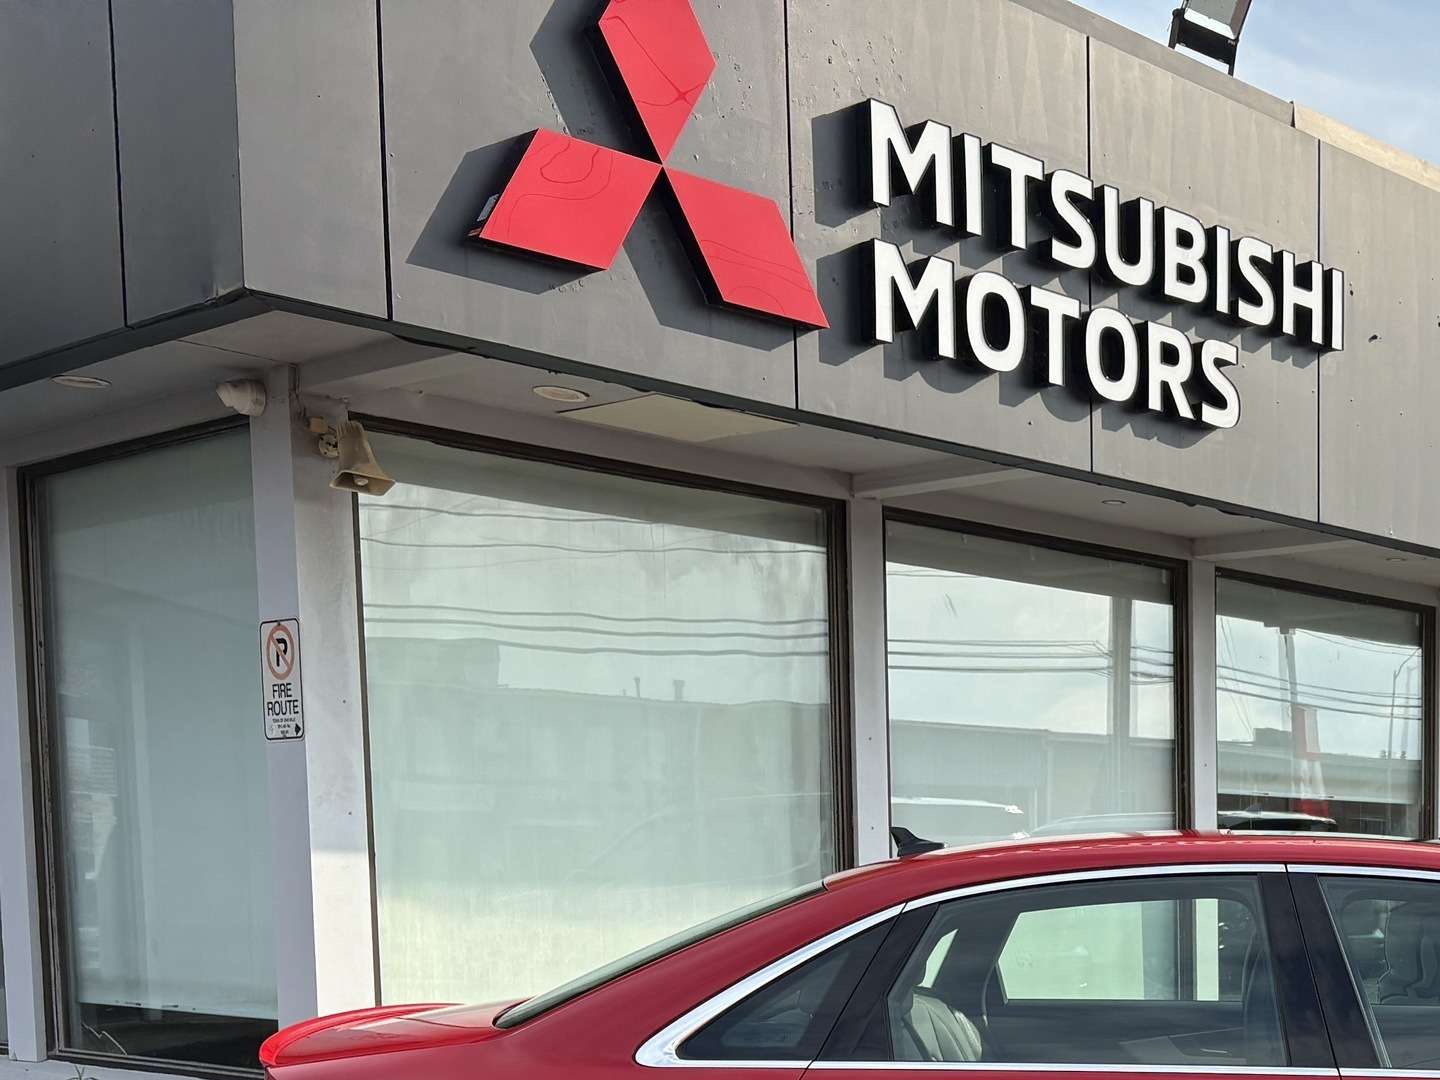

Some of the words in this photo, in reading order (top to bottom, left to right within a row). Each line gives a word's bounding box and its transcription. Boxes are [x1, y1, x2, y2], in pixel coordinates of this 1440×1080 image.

[870, 98, 1344, 351] MITSUBISHI
[873, 237, 1240, 429] MOTORS
[268, 700, 299, 716] ROUTE
[272, 683, 292, 699] FIRE
